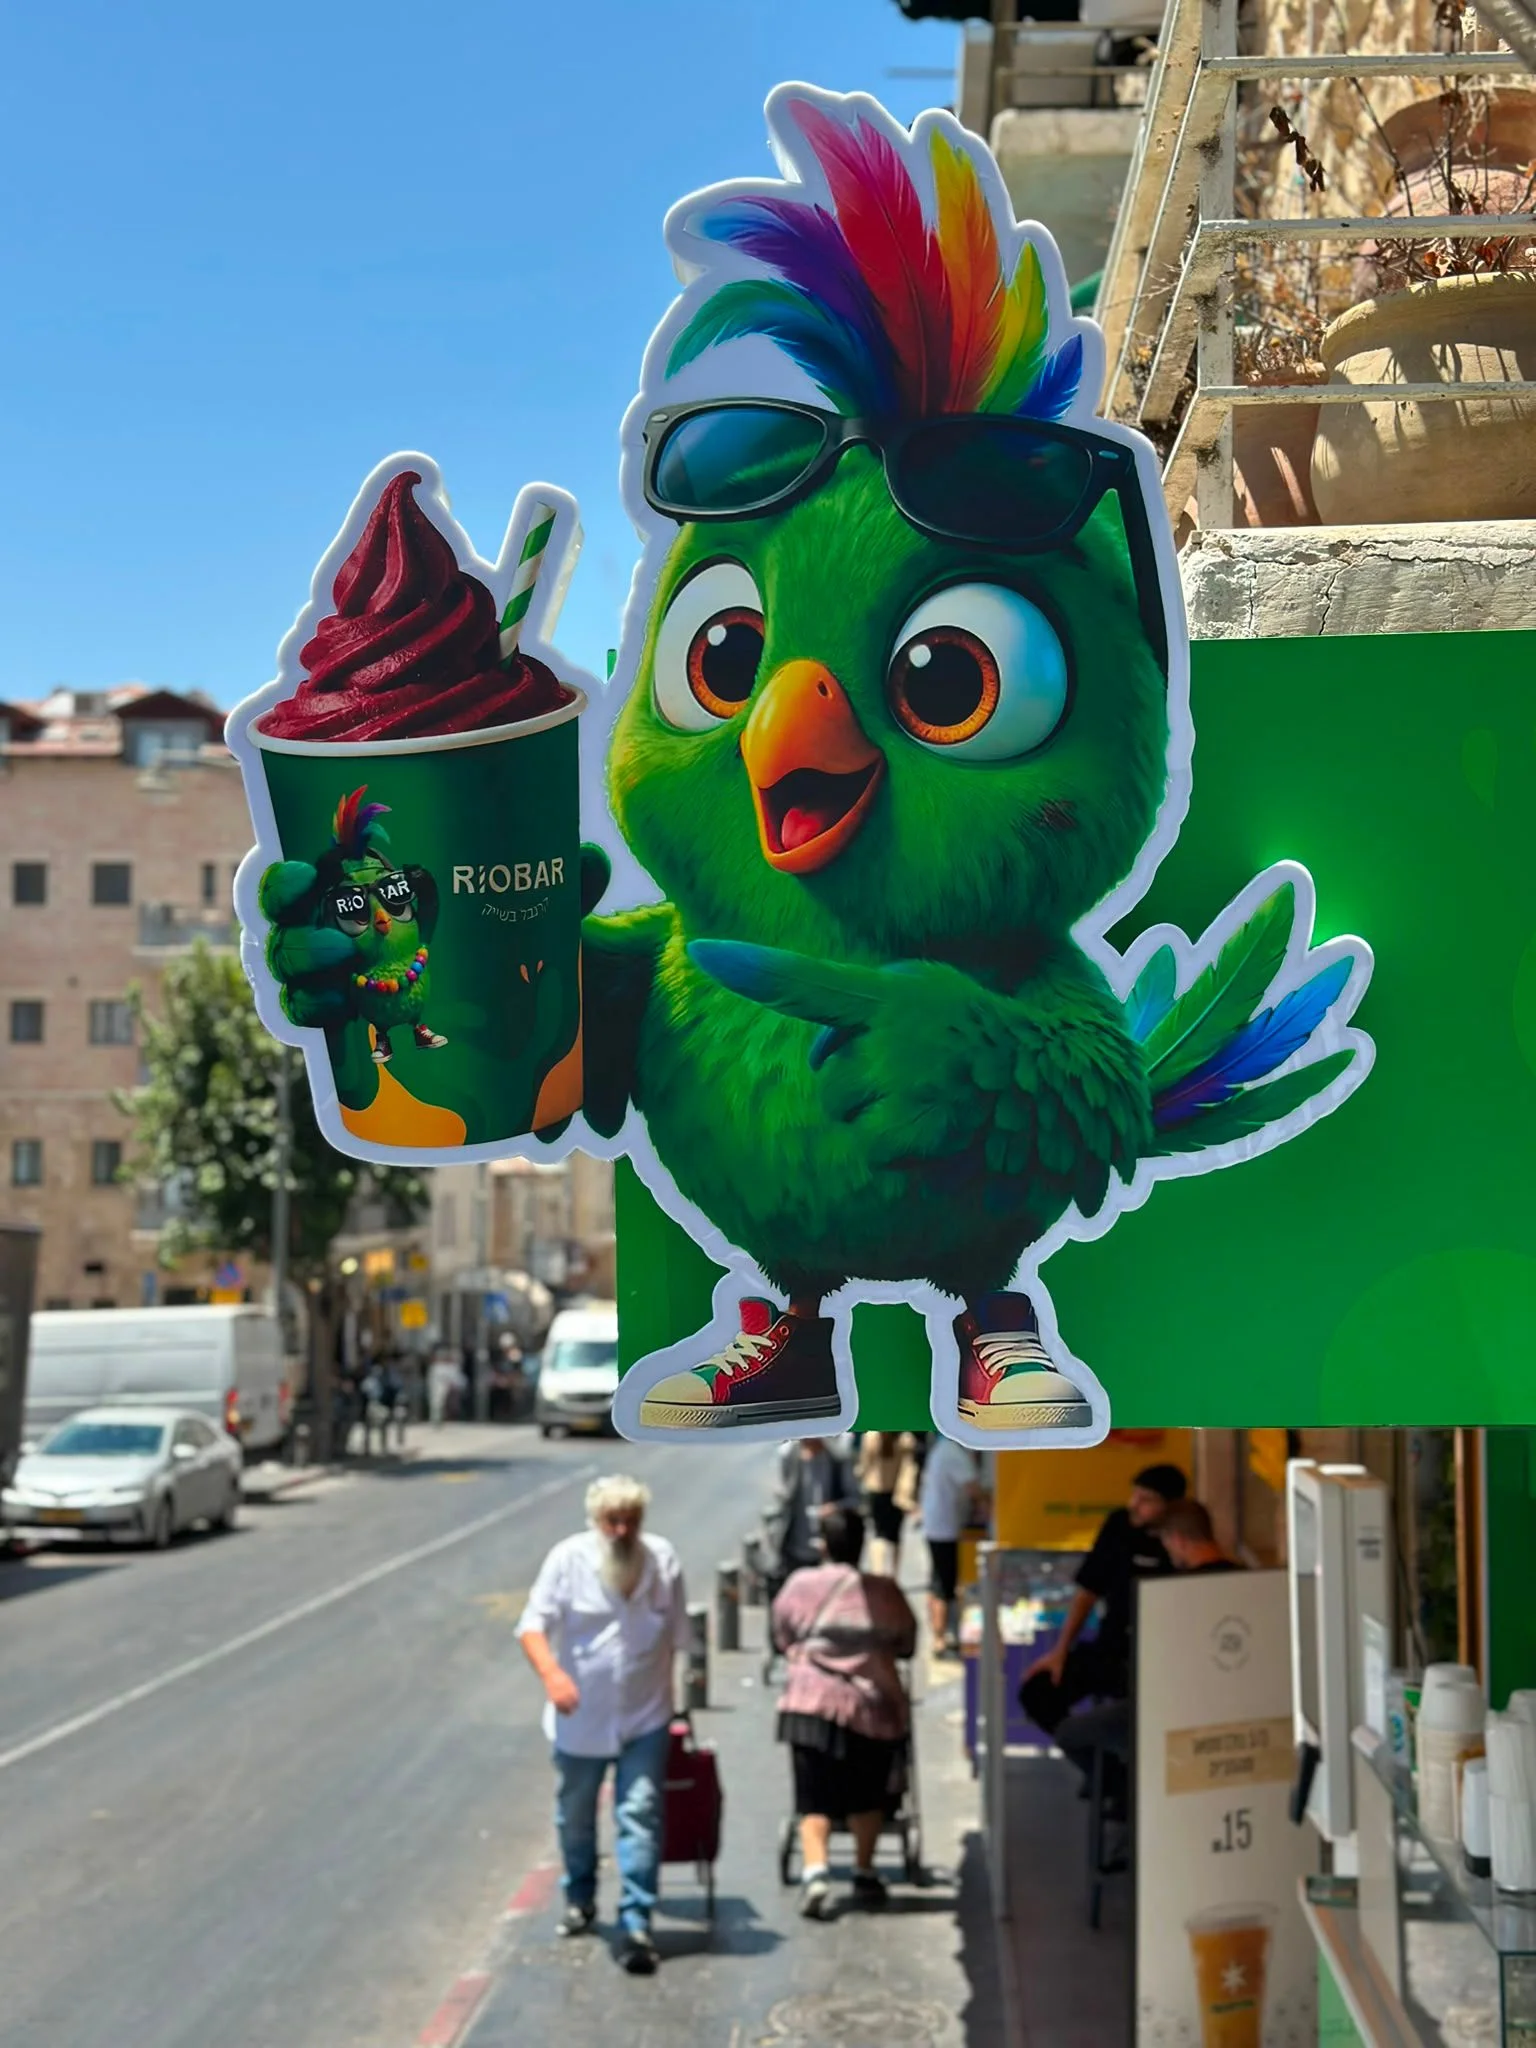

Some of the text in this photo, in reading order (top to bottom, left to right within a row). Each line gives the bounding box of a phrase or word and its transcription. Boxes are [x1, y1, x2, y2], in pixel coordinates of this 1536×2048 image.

[453, 857, 564, 893] RIOBAR
[336, 895, 364, 914] RIO
[1211, 1807, 1253, 1853] 15
